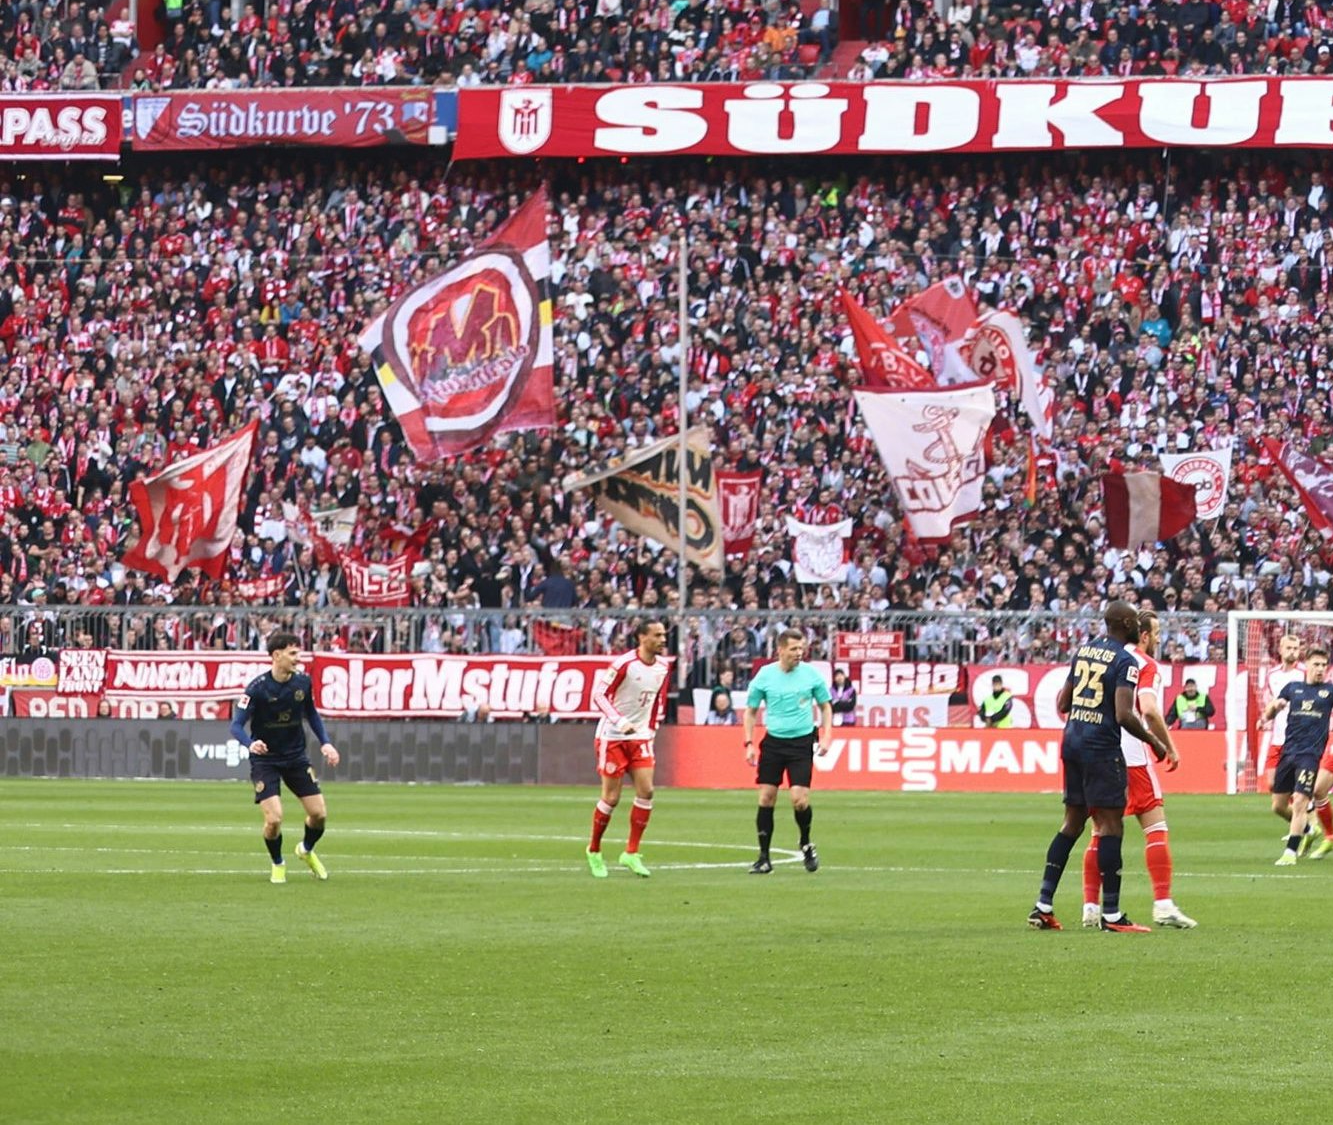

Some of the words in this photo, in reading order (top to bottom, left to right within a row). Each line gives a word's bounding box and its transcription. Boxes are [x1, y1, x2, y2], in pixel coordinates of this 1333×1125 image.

[177, 101, 337, 139] Südkurve
[60, 650, 107, 666] SEEN
[60, 666, 106, 681] LAND
[58, 679, 103, 693] FRONT
[1072, 660, 1108, 708] 23
